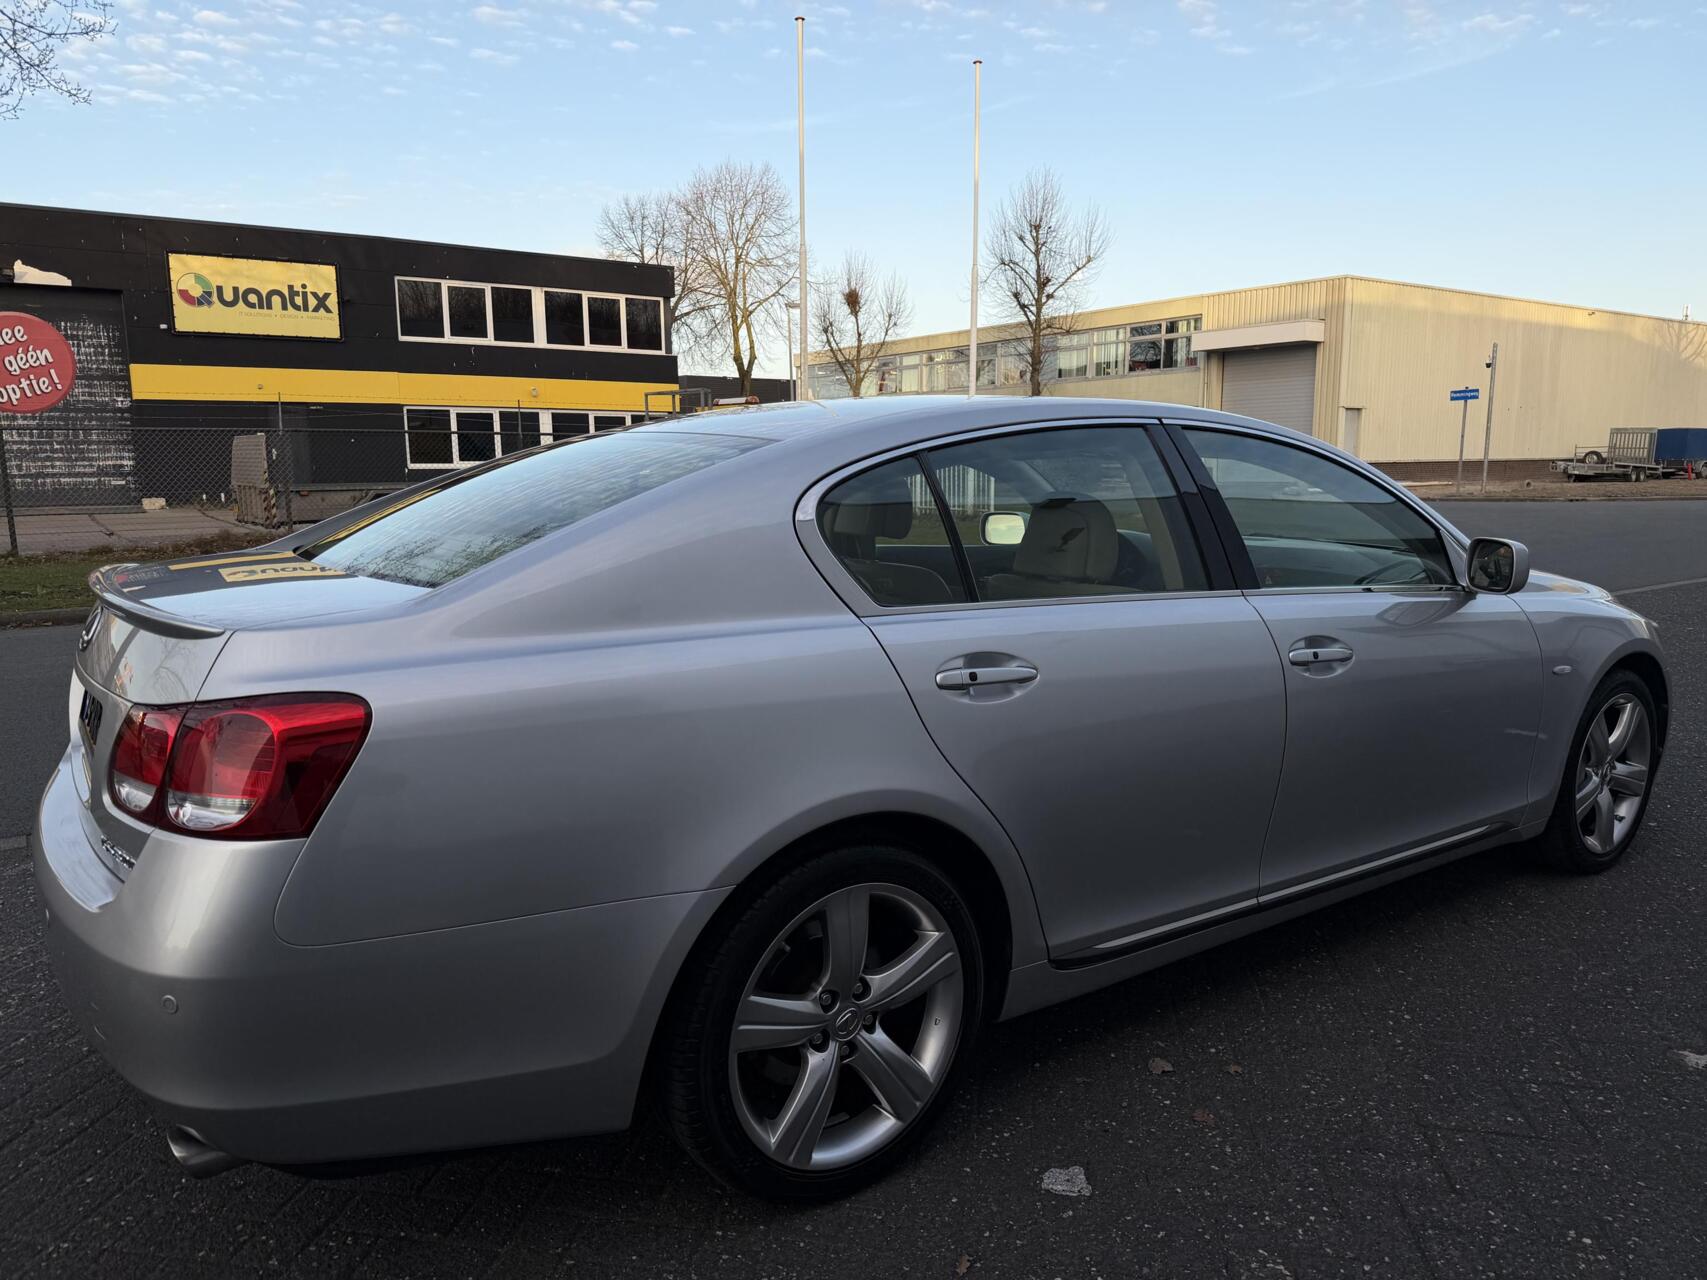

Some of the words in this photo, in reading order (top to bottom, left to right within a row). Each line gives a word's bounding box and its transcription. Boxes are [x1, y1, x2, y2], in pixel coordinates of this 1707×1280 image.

[176, 272, 334, 314] Quantix
[0, 325, 28, 346] ee
[4, 345, 54, 375] géén
[0, 368, 62, 405] optie!
